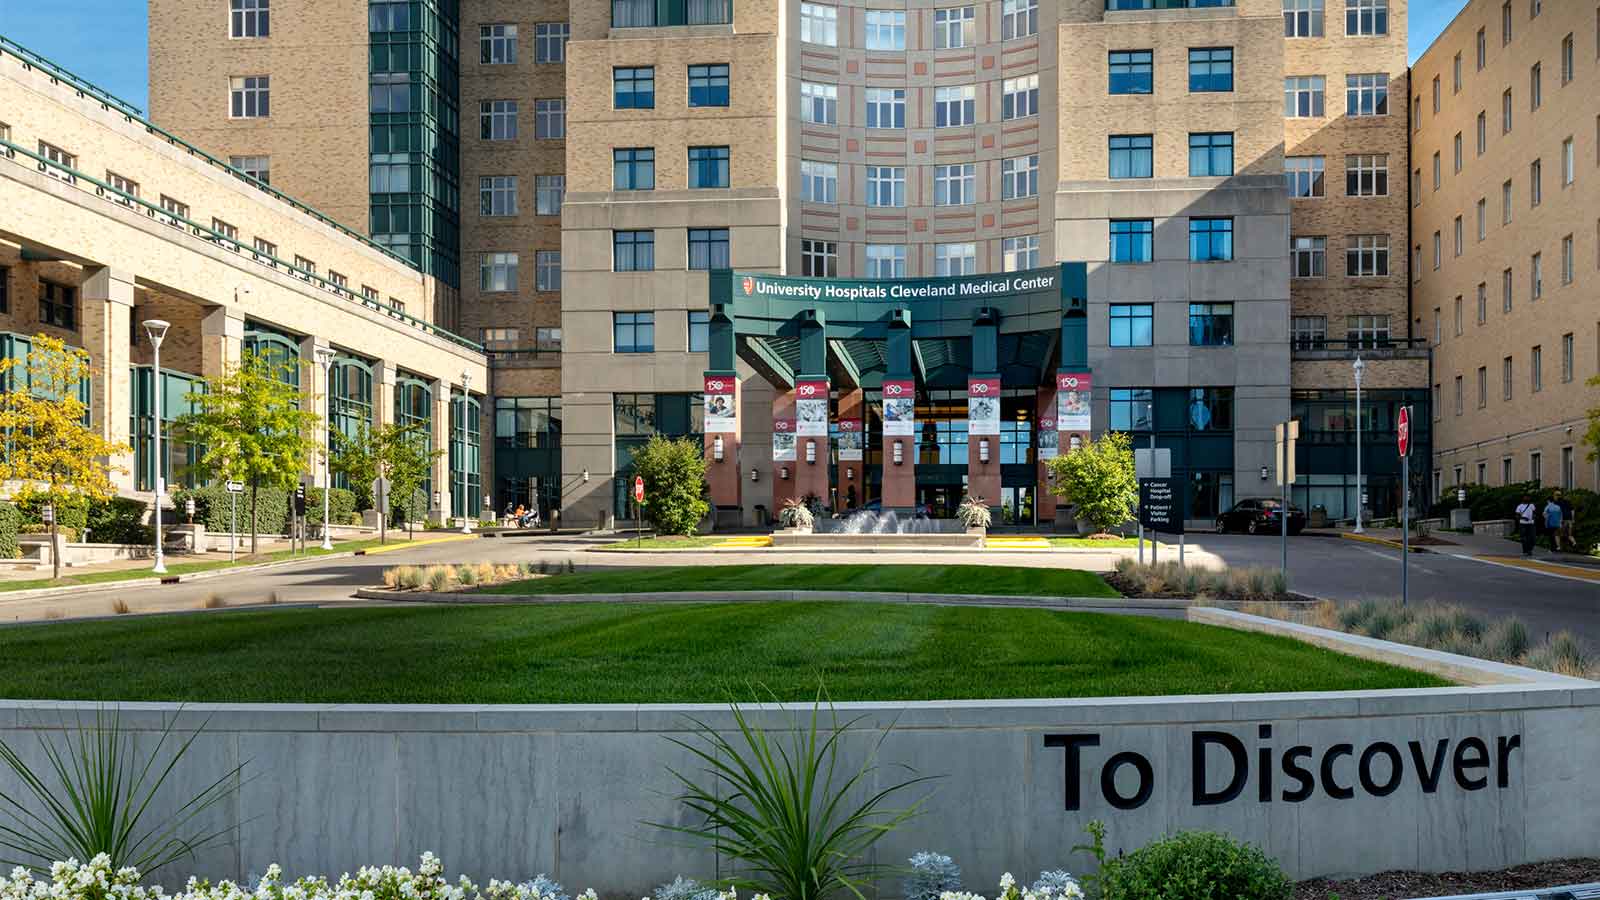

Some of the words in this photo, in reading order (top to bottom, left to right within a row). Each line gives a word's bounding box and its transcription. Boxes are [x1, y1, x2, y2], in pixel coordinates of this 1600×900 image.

[756, 281, 822, 299] University
[825, 285, 887, 300] Hospitals
[890, 283, 956, 298] Cleveland
[959, 279, 1010, 295] Medical
[1013, 276, 1055, 291] Center
[707, 380, 724, 391] 150
[971, 383, 988, 393] 150
[1061, 377, 1079, 388] 150
[799, 385, 815, 396] 150
[886, 384, 902, 395] 150
[1044, 733, 1155, 811] To
[1191, 724, 1521, 806] Discover
